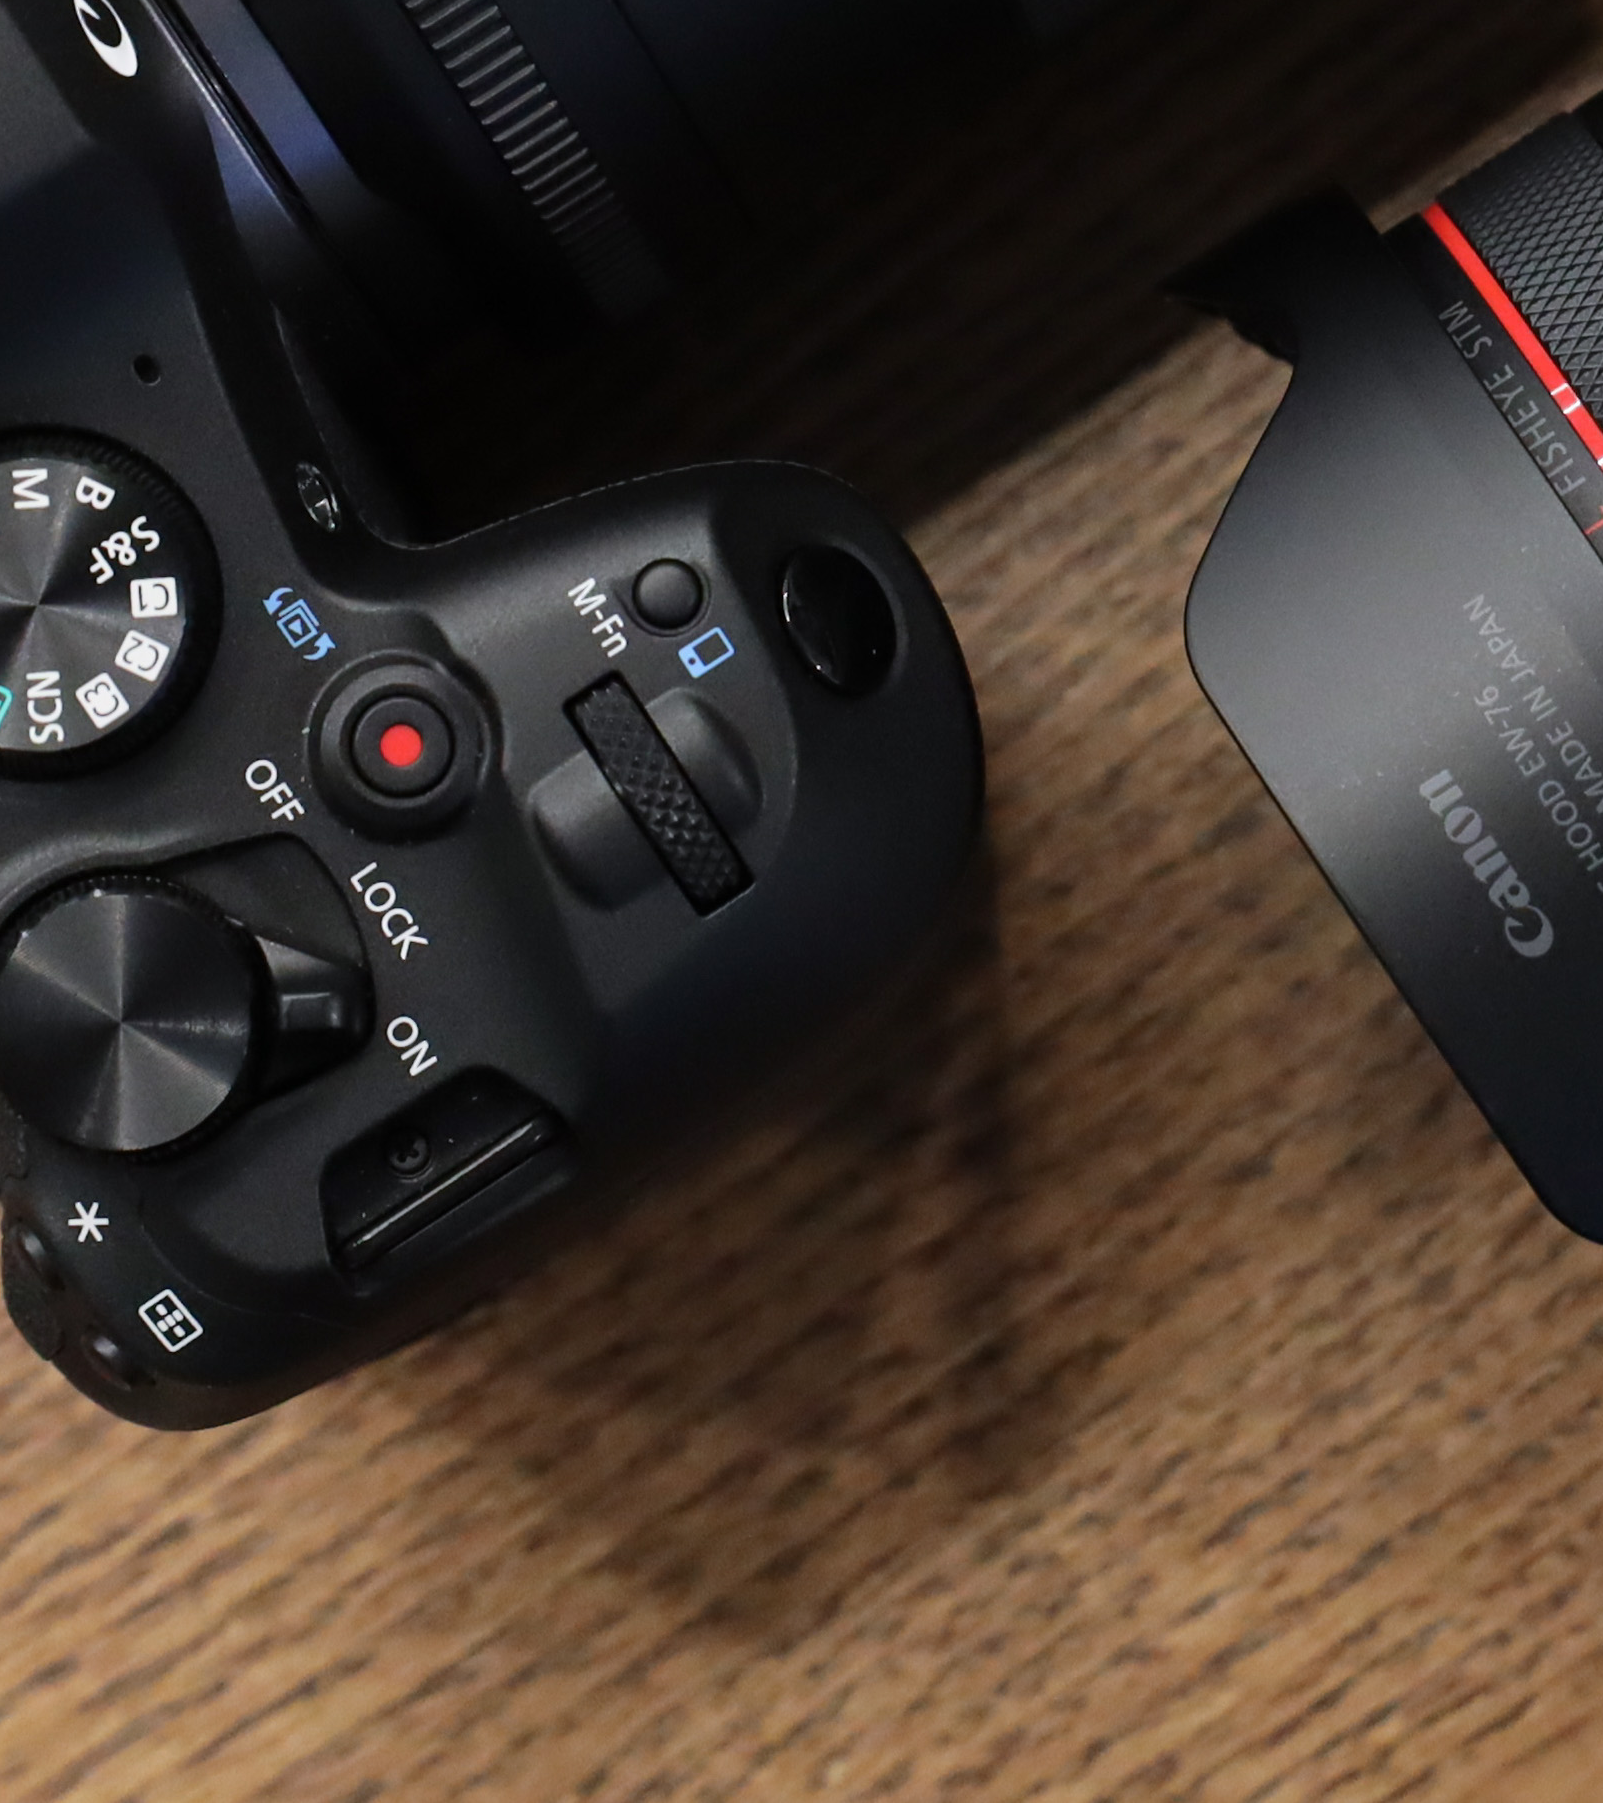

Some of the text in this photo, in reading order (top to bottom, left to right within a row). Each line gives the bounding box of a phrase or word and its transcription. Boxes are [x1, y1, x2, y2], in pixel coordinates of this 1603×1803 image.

[1438, 300, 1493, 360] STM
[1483, 364, 1587, 497] FISHEYE
[12, 468, 50, 509] M
[75, 476, 115, 510] B
[89, 516, 160, 584] S&F
[567, 577, 629, 658] M-Fn
[1463, 594, 1535, 683] JAPAN
[26, 671, 64, 744] SCN
[1473, 685, 1548, 778] EW-76
[1522, 684, 1558, 722] IN
[245, 759, 305, 822] OFF
[1419, 769, 1554, 959] Canon
[350, 861, 430, 961] LOCK
[386, 1015, 438, 1077] ON
